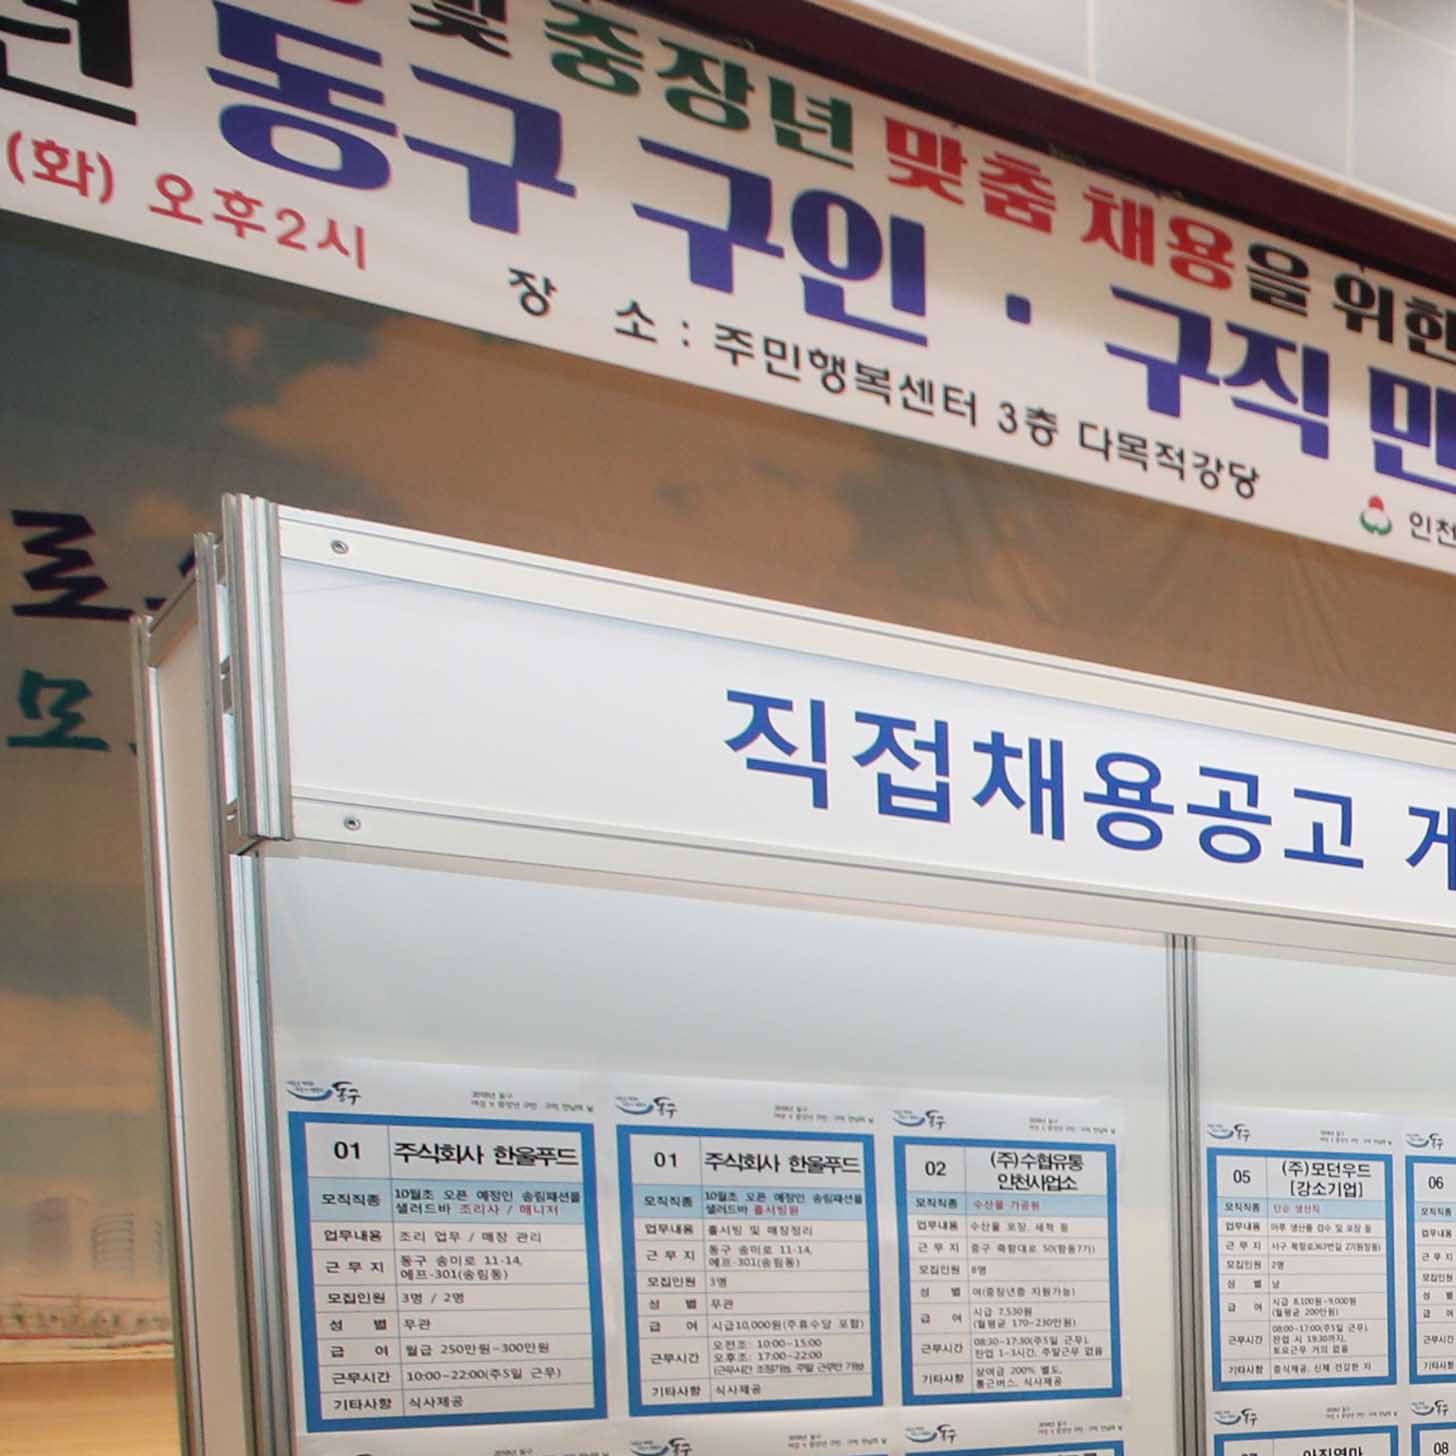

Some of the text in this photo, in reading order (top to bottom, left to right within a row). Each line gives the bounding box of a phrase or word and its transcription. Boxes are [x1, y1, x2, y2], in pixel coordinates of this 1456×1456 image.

[544, 0, 854, 170] 중장년
[885, 117, 1057, 235] 맞춤
[1081, 185, 1312, 318] 채용을
[7, 130, 366, 270] (화) 오후2시
[206, 0, 576, 235] 동구
[633, 137, 927, 347] 구인
[1104, 285, 1330, 460] 구직
[713, 321, 977, 427] 주민행복센터
[997, 399, 1059, 449] 3층
[1078, 419, 1260, 499] 다목적강당
[724, 687, 1364, 870] 직접채용공고
[334, 1141, 360, 1160] 01
[394, 1142, 579, 1166] 주식회사 한울푸드
[654, 1152, 677, 1167] 01
[705, 1153, 860, 1174] 주식회사 한울푸드
[991, 1151, 1084, 1171] (주)수협유통
[925, 1162, 946, 1176] 02
[1282, 1161, 1371, 1179] (주)모던우드
[998, 1174, 1078, 1192] 인천사업소
[1233, 1170, 1250, 1183] 05
[1428, 1176, 1444, 1189] 06
[1291, 1182, 1363, 1198] [강소기업]
[460, 1205, 499, 1215] 조리사
[519, 1205, 559, 1216] 매니저
[324, 1231, 382, 1242] 업무내용
[400, 1232, 426, 1242] 조리
[435, 1232, 461, 1243] 업무
[516, 1232, 541, 1243] 관리
[328, 1293, 386, 1304] 모집인원
[404, 1319, 431, 1330] 무관
[407, 1344, 432, 1356] 월급
[651, 1353, 699, 1364] 근무시간
[332, 1373, 390, 1385] 근무시간
[652, 1386, 700, 1397] 기타사항
[335, 1398, 392, 1410] 기타사항
[409, 1396, 463, 1408] 식사제공
[1434, 1442, 1448, 1455] 08
